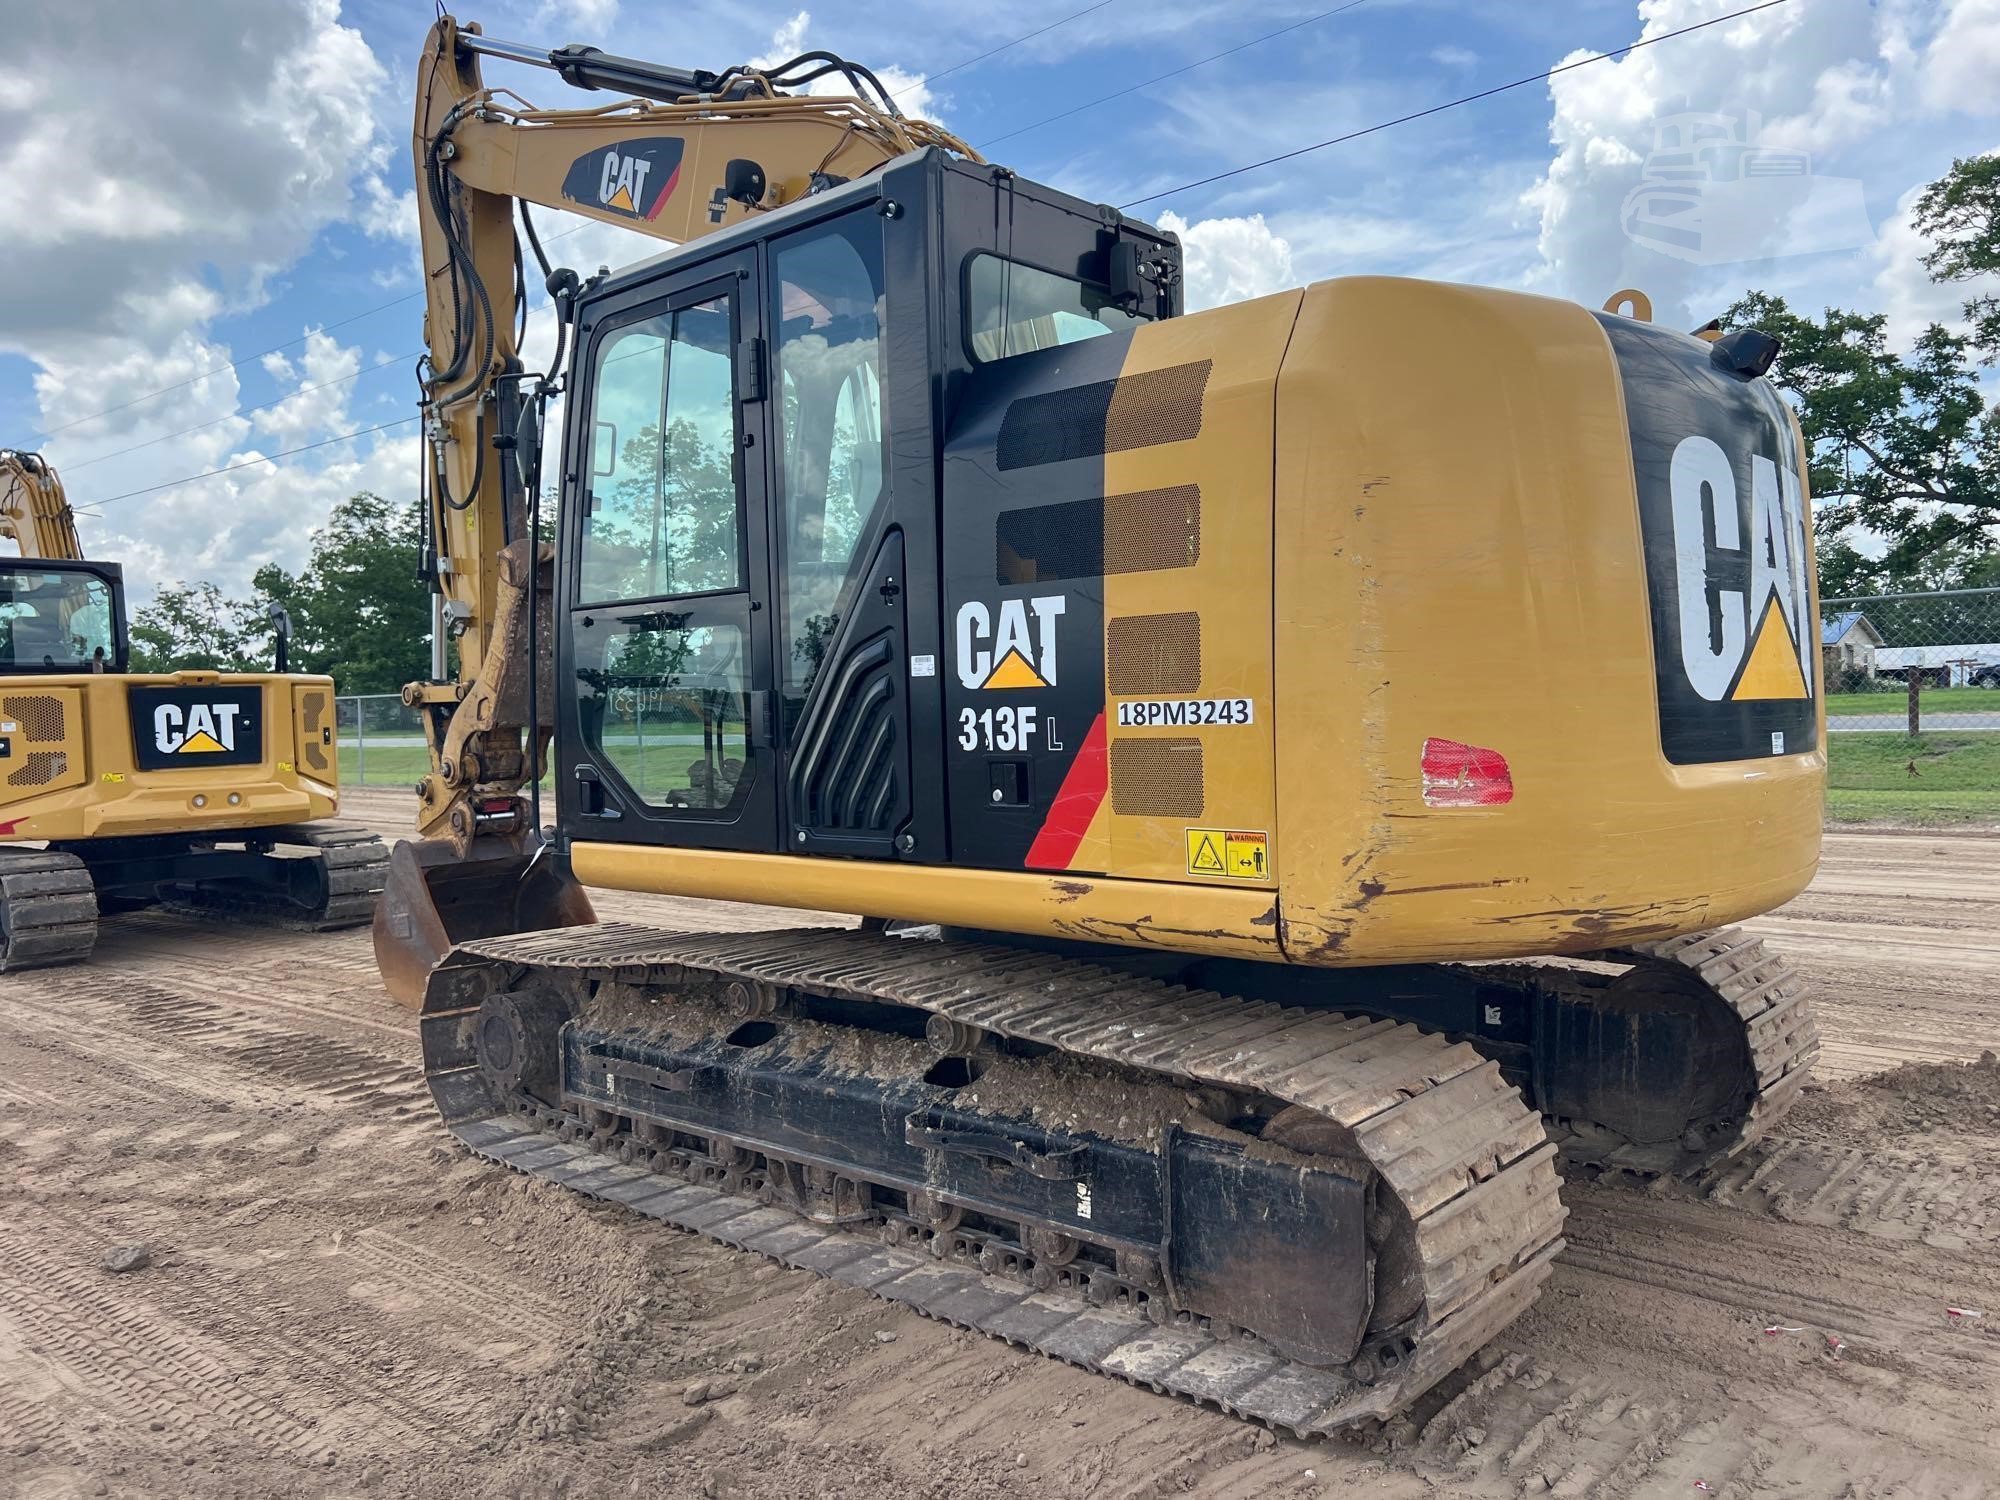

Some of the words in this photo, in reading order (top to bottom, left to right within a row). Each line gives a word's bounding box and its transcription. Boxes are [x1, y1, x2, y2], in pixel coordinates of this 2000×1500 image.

[600, 152, 651, 213] CAT
[1670, 436, 1812, 700] CAT
[956, 595, 1066, 690] CAT
[154, 704, 240, 753] CAT
[958, 706, 1037, 751] 313F
[1047, 717, 1064, 750] L
[1119, 699, 1249, 726] 18PM3243
[1234, 834, 1264, 843] WARNING
